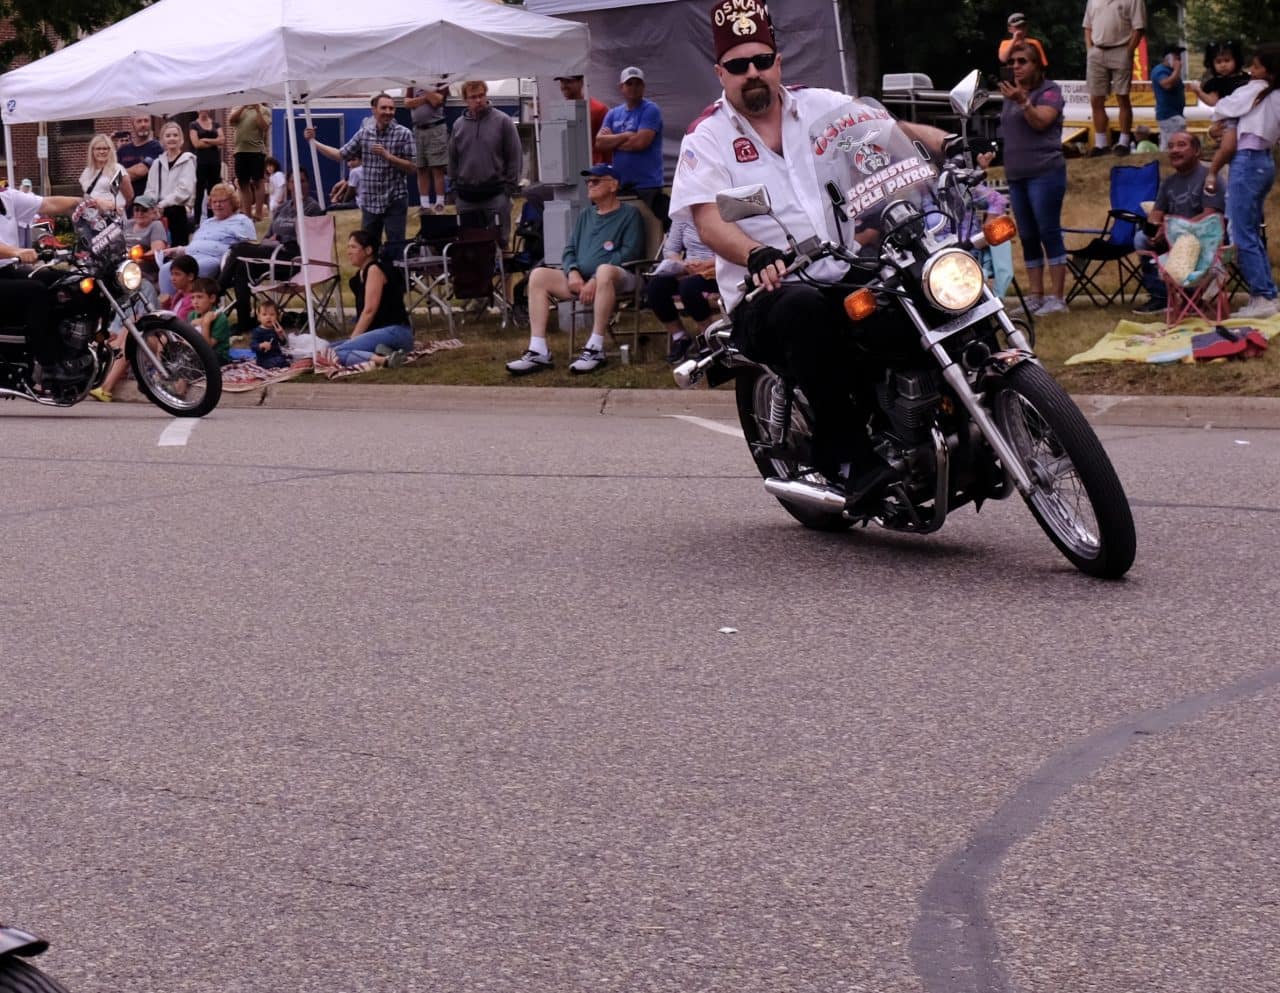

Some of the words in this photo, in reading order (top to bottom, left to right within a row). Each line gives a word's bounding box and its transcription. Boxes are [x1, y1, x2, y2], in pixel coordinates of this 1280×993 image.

[846, 186, 886, 218] CYCLE
[886, 165, 937, 194] PATROL
[847, 157, 920, 201] ROCHESTER
